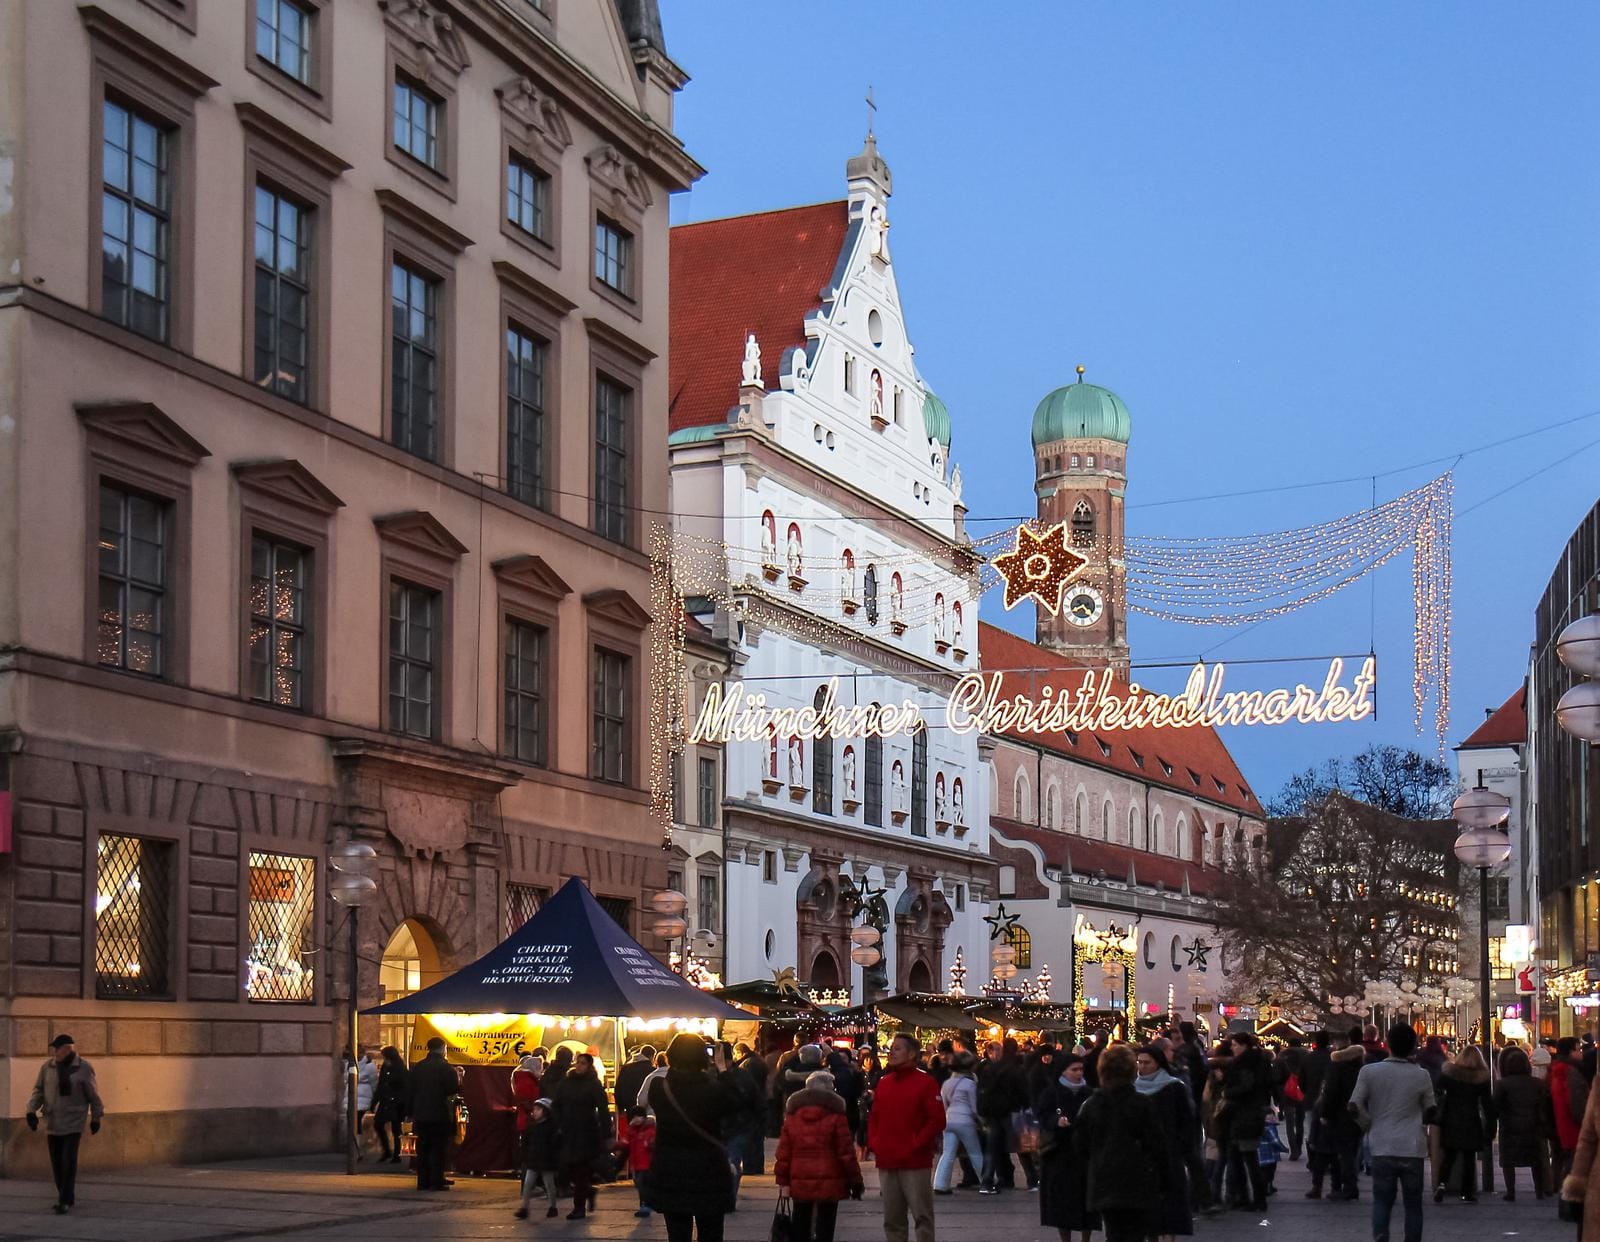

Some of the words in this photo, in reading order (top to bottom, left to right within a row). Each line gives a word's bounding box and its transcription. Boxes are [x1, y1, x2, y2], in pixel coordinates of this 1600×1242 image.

[688, 676, 924, 744] Münchner
[946, 656, 1376, 735] Christkindlmarkt
[517, 945, 572, 954] CHARITY
[512, 955, 569, 964] VERKAUF
[502, 966, 535, 974] ORIG.
[538, 964, 574, 974] THÜR.
[481, 974, 573, 984] BRATWÜRSTEN
